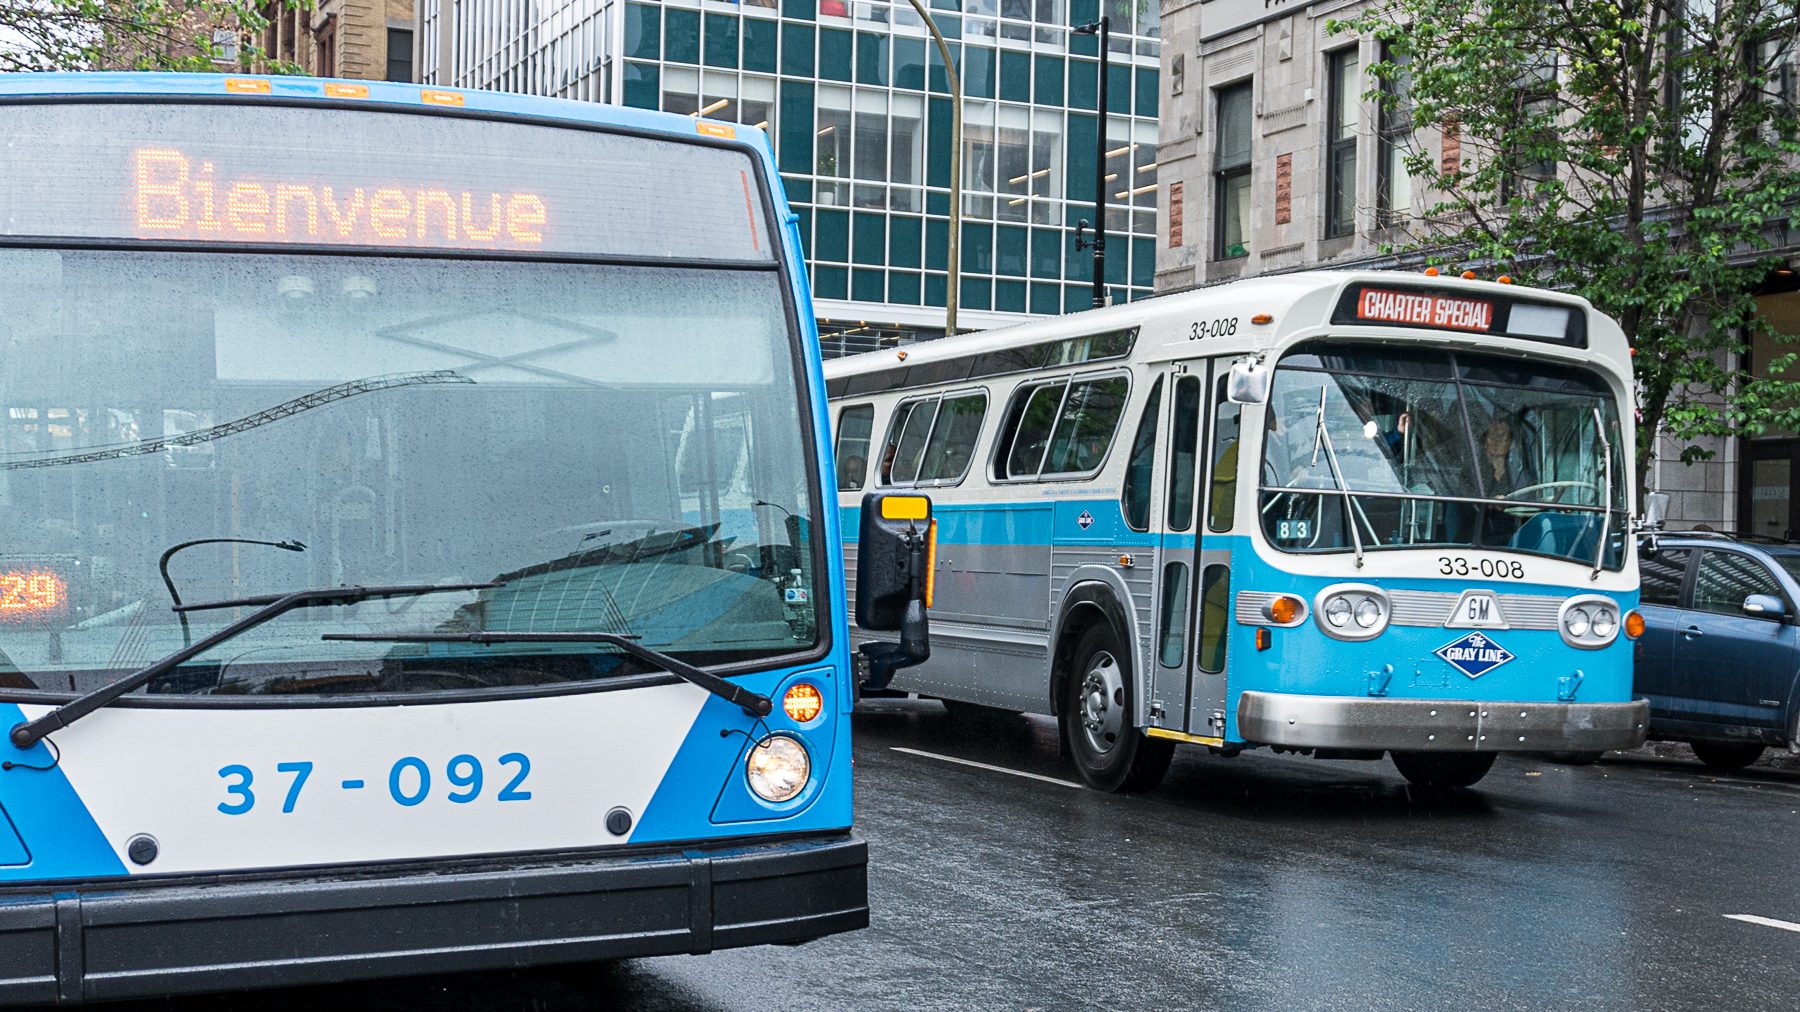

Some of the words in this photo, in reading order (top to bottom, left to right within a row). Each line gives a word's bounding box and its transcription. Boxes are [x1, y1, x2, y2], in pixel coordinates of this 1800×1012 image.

[136, 148, 547, 243] Bienvenue
[1364, 291, 1432, 323] CHARTER
[1434, 299, 1490, 328] SPECIAL
[1189, 317, 1238, 341] 33-008
[1438, 557, 1525, 579] 33-008
[0, 575, 57, 608] 29
[1468, 598, 1490, 620] GM
[1468, 635, 1486, 648] The
[1446, 647, 1478, 661] GRAY
[1478, 648, 1504, 662] LINE
